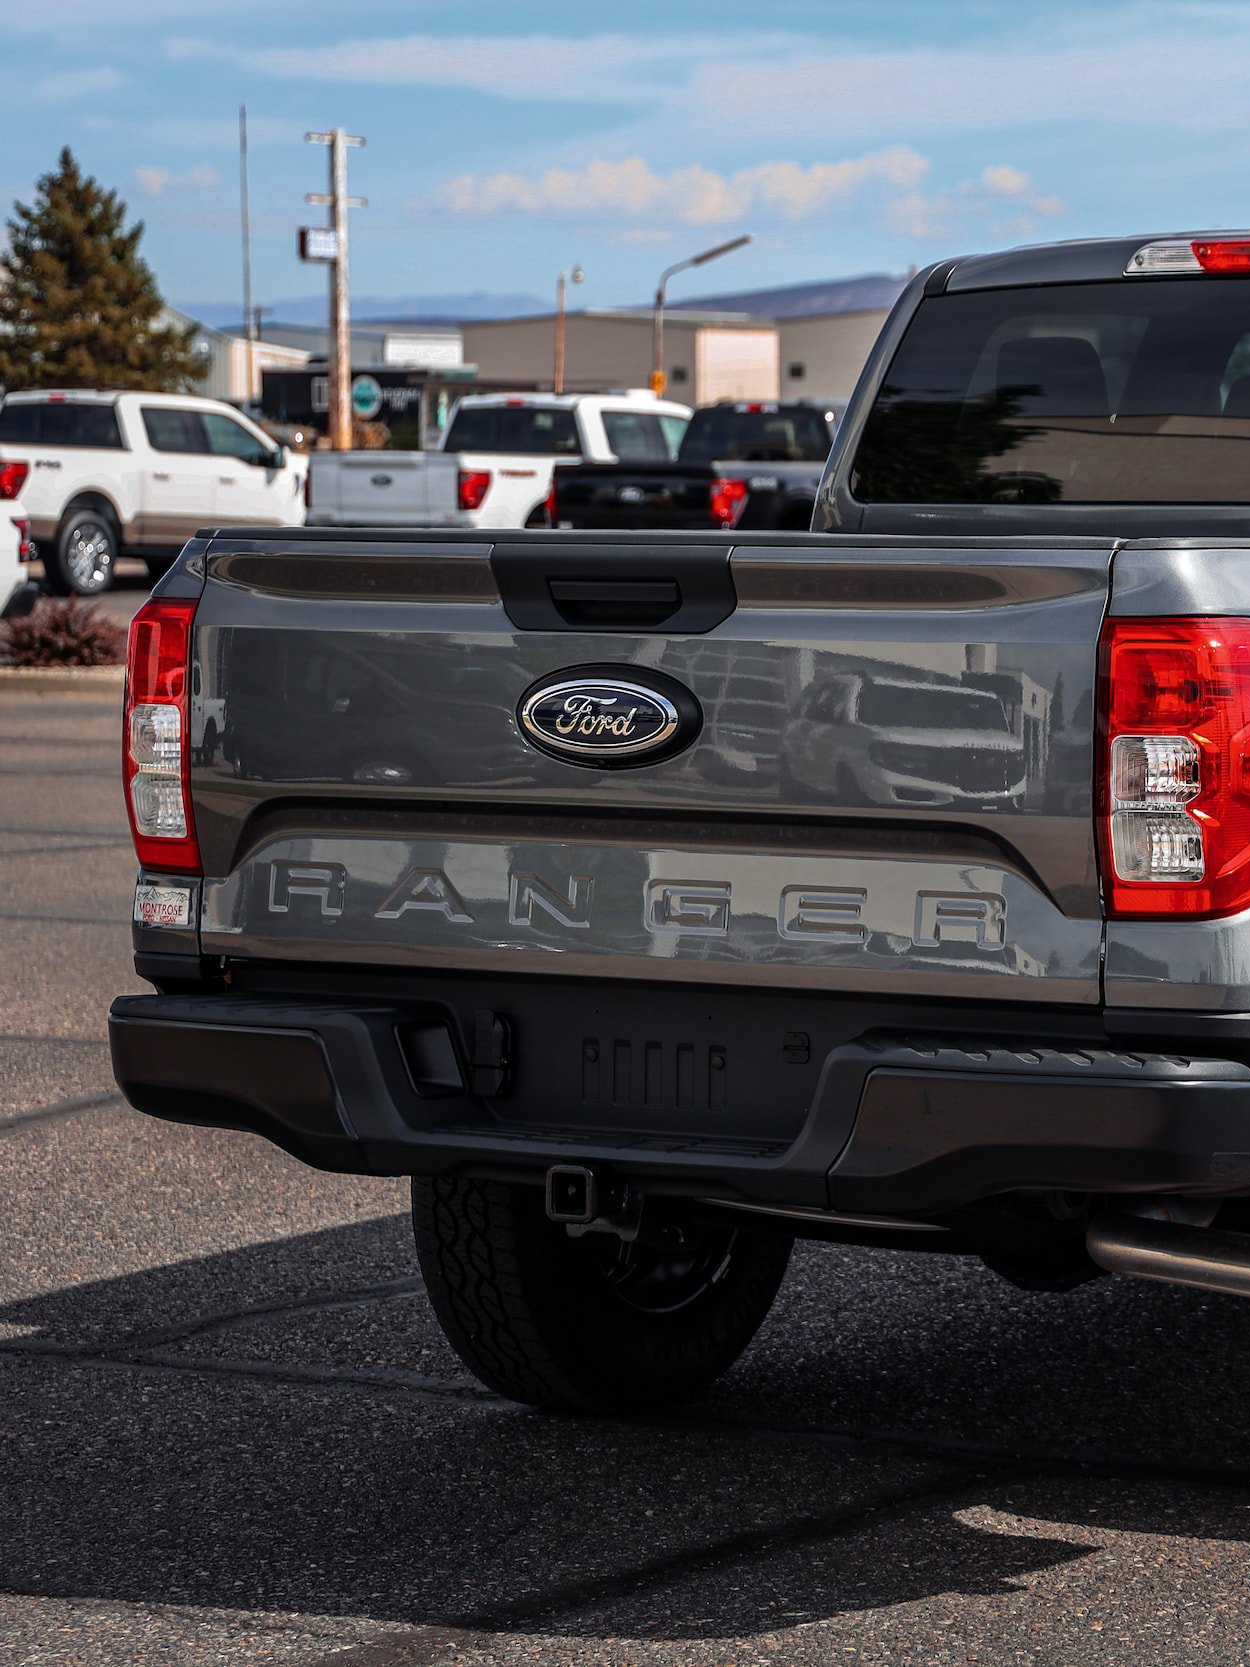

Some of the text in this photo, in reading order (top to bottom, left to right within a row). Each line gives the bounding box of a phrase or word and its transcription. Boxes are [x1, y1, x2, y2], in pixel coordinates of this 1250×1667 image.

[555, 694, 638, 736] Ford
[139, 902, 183, 916] MONTROSE
[143, 914, 155, 922] FORD
[159, 915, 176, 923] NISSAN
[267, 857, 1008, 953] RANGER
